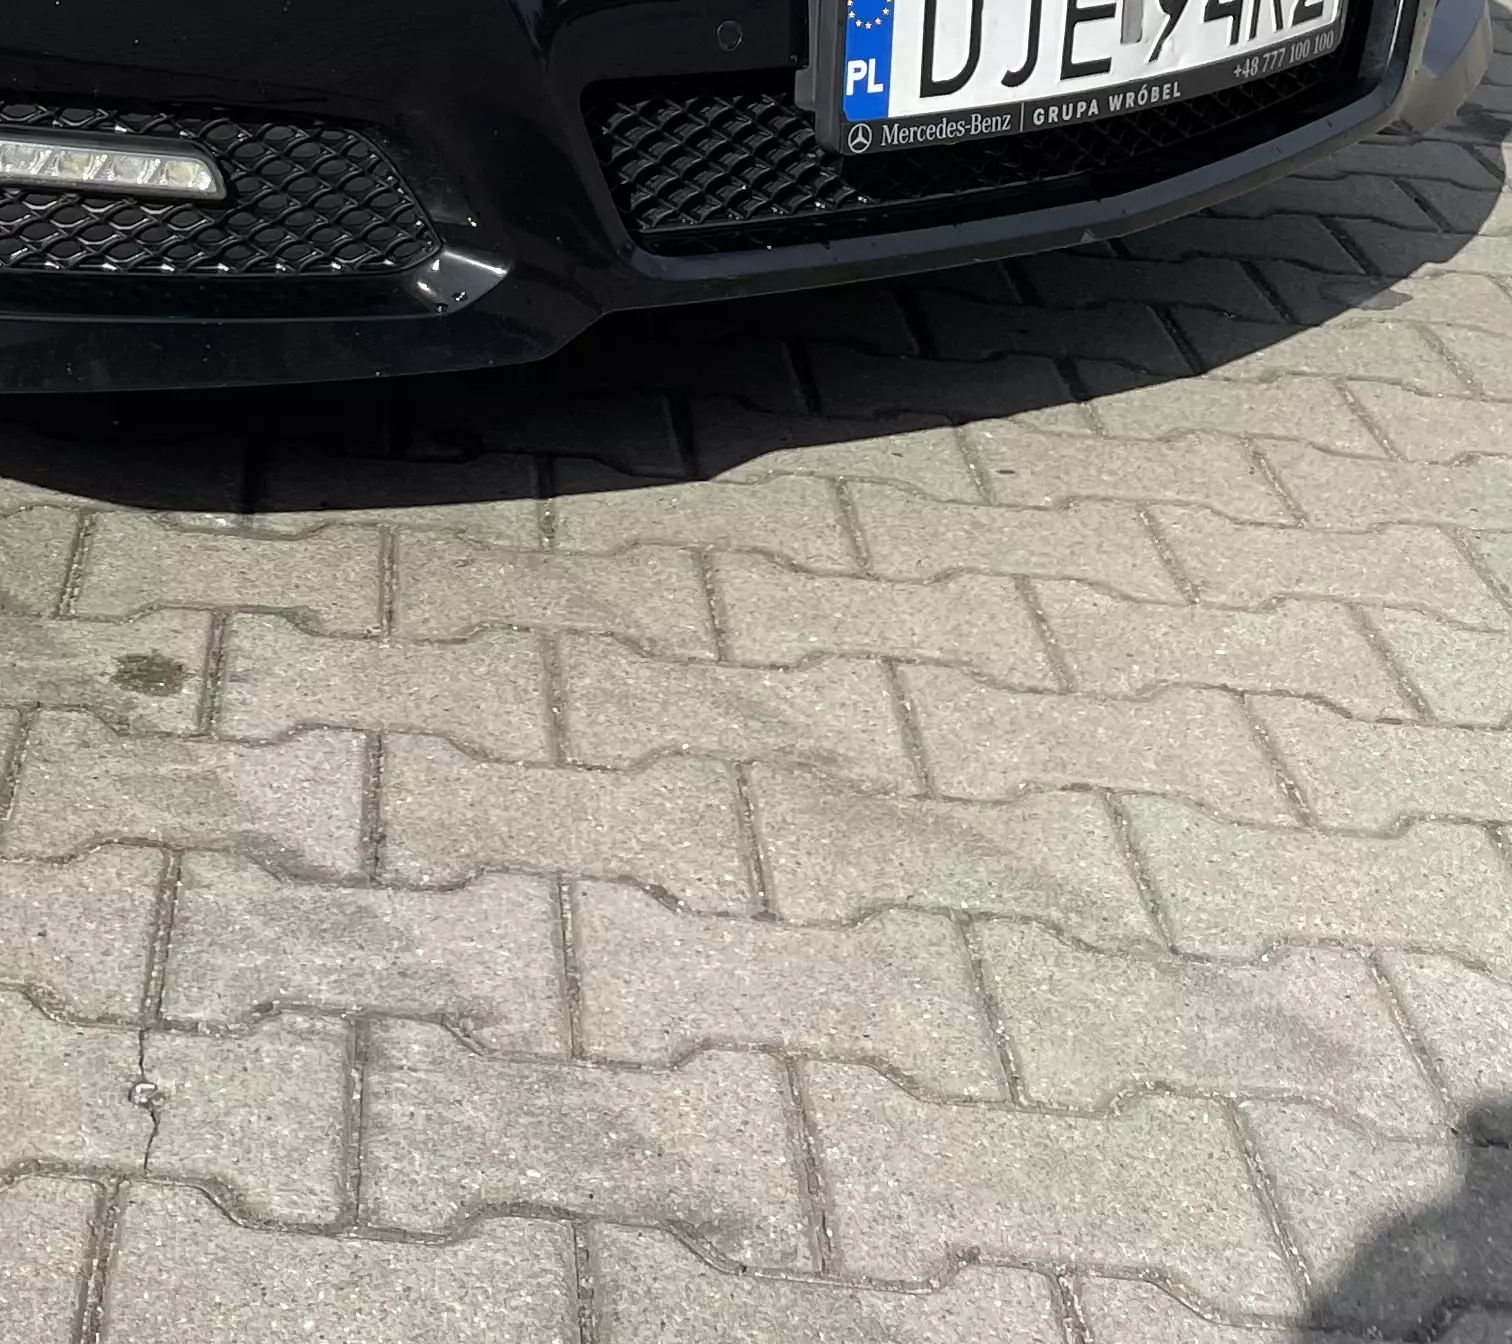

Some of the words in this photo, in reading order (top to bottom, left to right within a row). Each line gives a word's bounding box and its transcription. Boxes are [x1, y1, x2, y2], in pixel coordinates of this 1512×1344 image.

[1233, 56, 1260, 78] +48
[1262, 47, 1286, 72] 777
[1289, 39, 1311, 63] 100
[1313, 30, 1334, 54] 100
[845, 58, 884, 96] PL
[1033, 99, 1100, 126] GRUPA
[1108, 81, 1181, 112] WRÓBEL
[880, 113, 1011, 147] Mercedes-Benz
